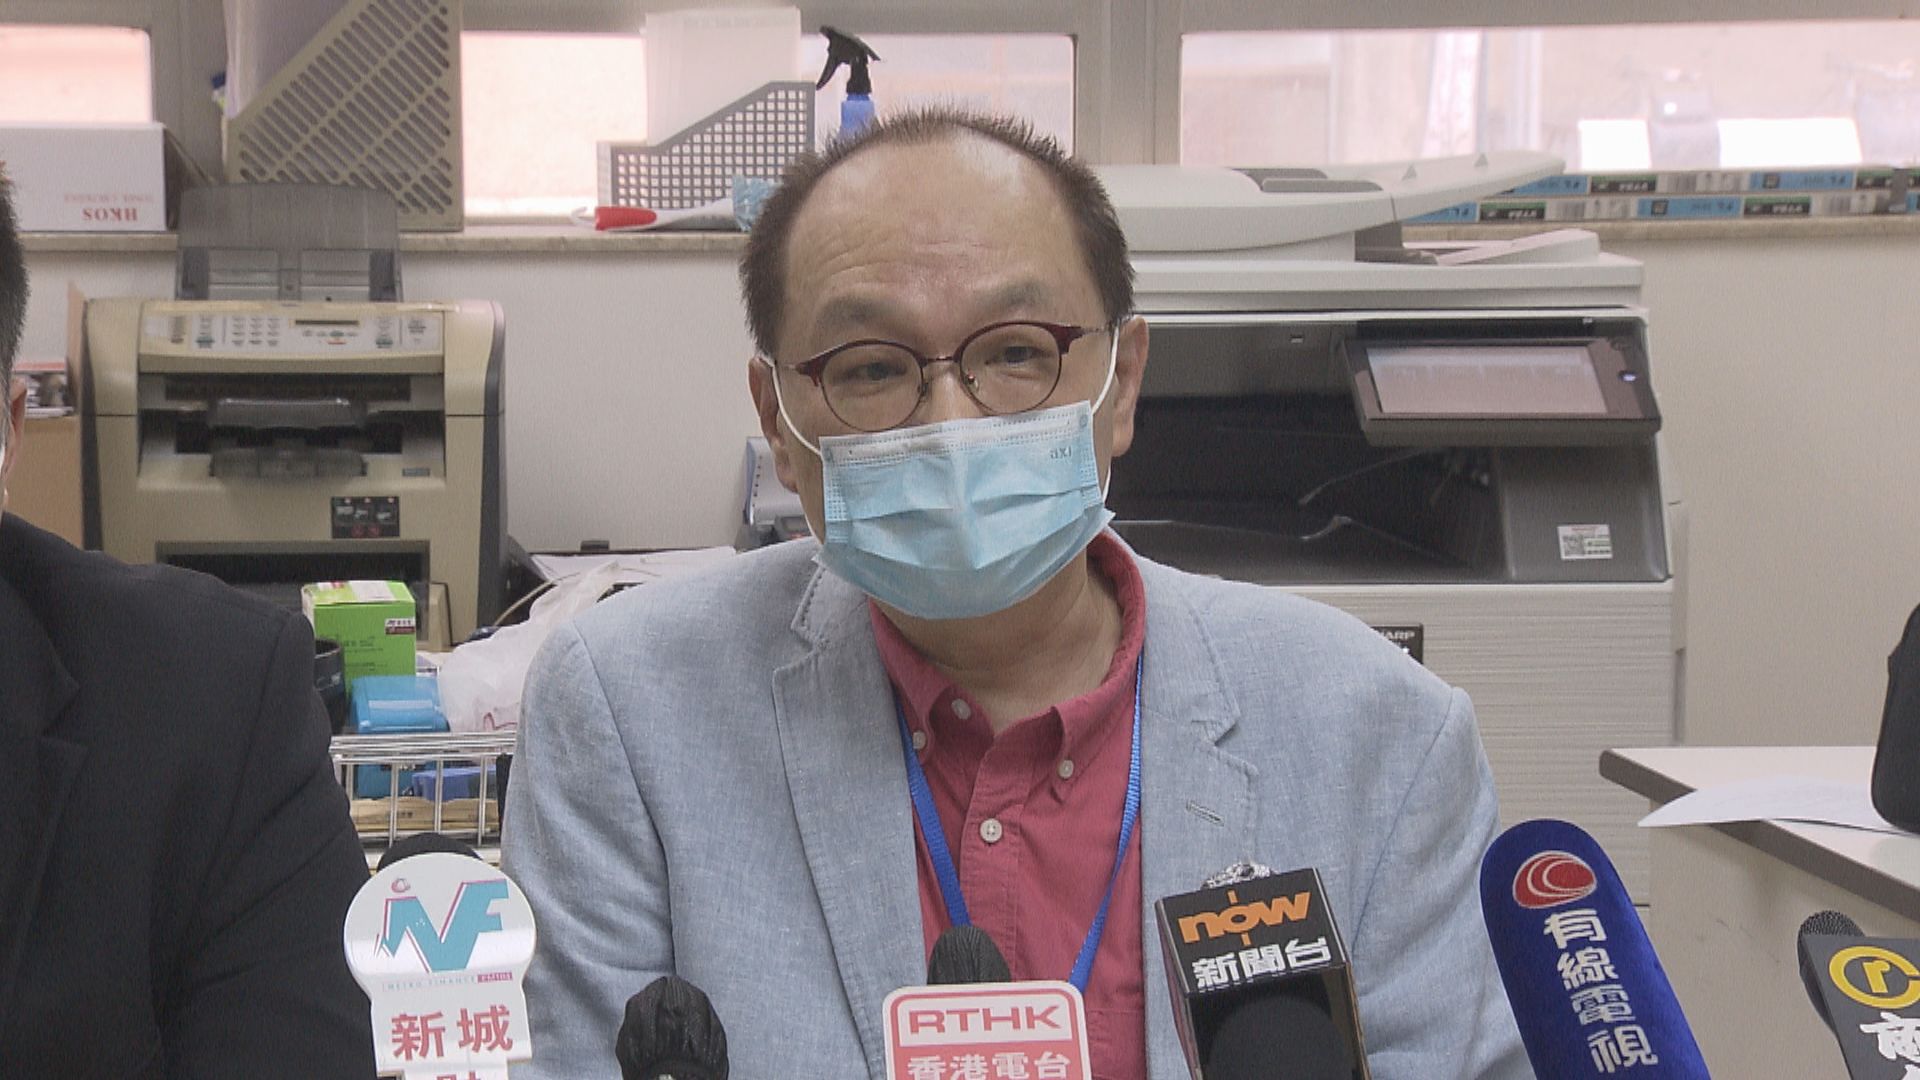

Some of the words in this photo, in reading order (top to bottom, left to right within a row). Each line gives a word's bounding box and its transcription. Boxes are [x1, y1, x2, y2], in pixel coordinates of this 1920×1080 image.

[82, 208, 138, 221] HKOS
[1381, 630, 1415, 640] ARP
[1177, 891, 1312, 945] now
[1191, 936, 1332, 988] 新聞台
[1543, 908, 1659, 1073] 有線電視
[391, 1004, 513, 1061] 新城
[908, 1005, 1061, 1034] RTHK
[907, 1051, 1071, 1080] 香港電台
